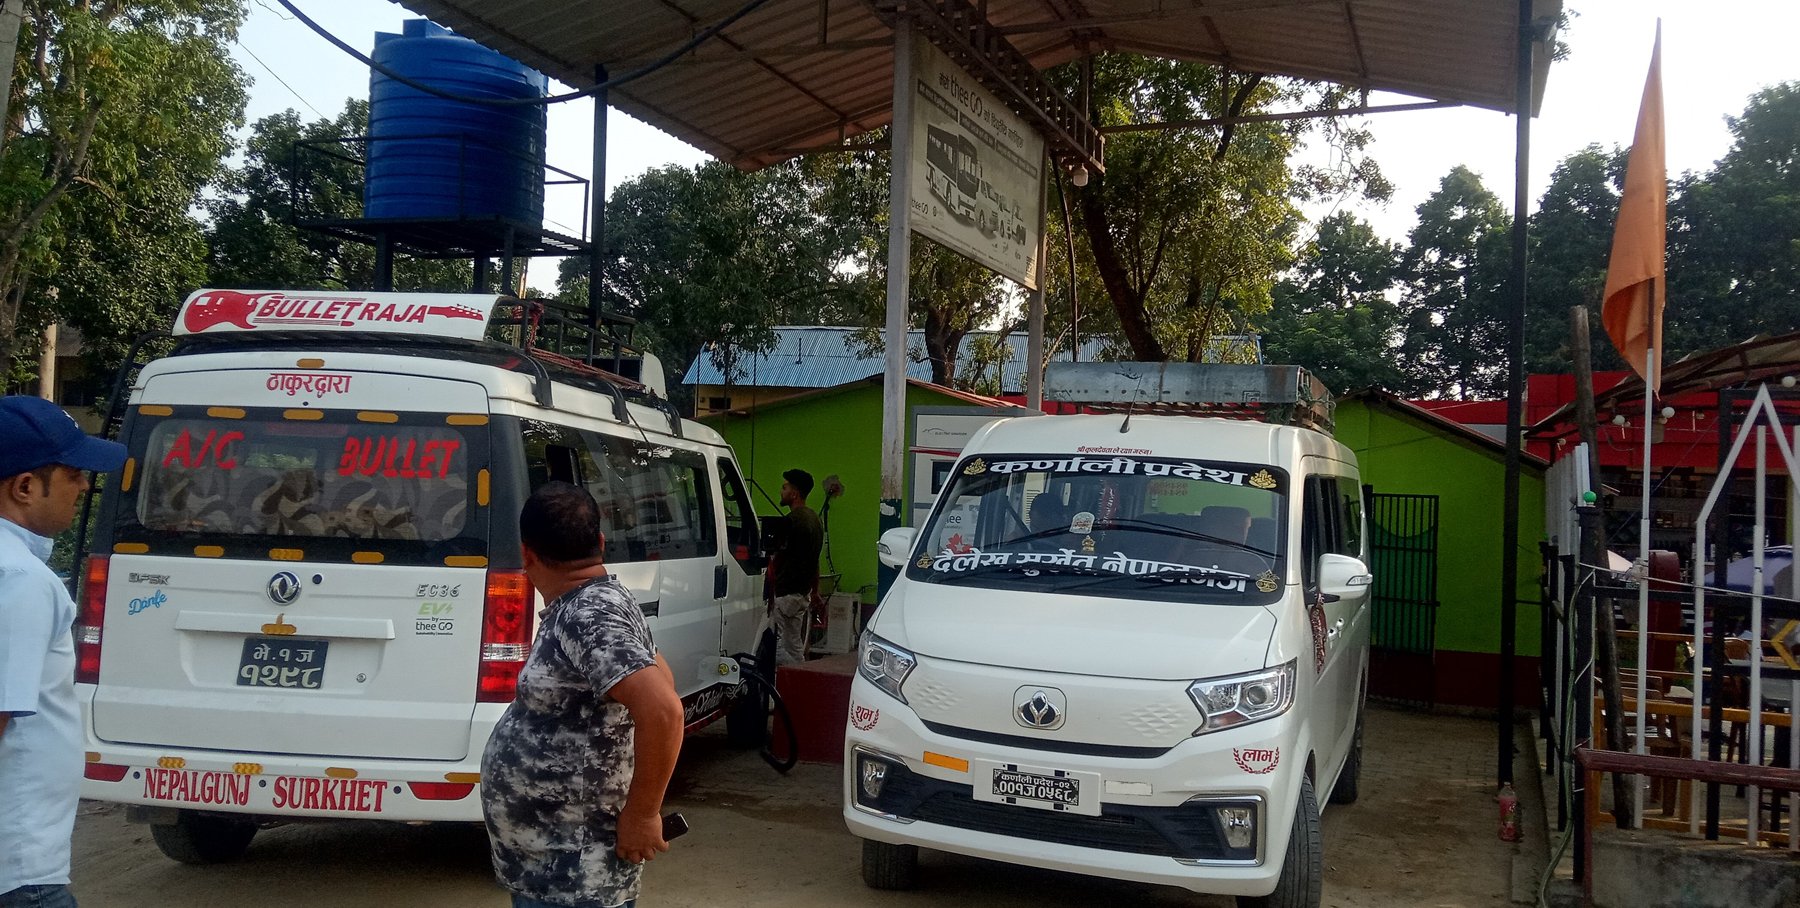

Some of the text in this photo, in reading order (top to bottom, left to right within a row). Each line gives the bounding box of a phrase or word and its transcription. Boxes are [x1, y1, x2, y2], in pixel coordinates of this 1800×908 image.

[258, 298, 427, 323] BULLET RAJA
[266, 373, 352, 398] ठाकुरद्वारा
[162, 427, 459, 479] A/C BULLET
[990, 457, 1248, 486] कर्णाली प्रदेश
[416, 584, 461, 597] EC36
[415, 621, 453, 631] thee GO
[295, 649, 315, 662] ज
[856, 705, 874, 722] शुभ
[1242, 748, 1274, 762] लाभ
[1001, 773, 1032, 784] कर्णाली
[143, 768, 388, 812] NEPALGUNJ SURKHET
